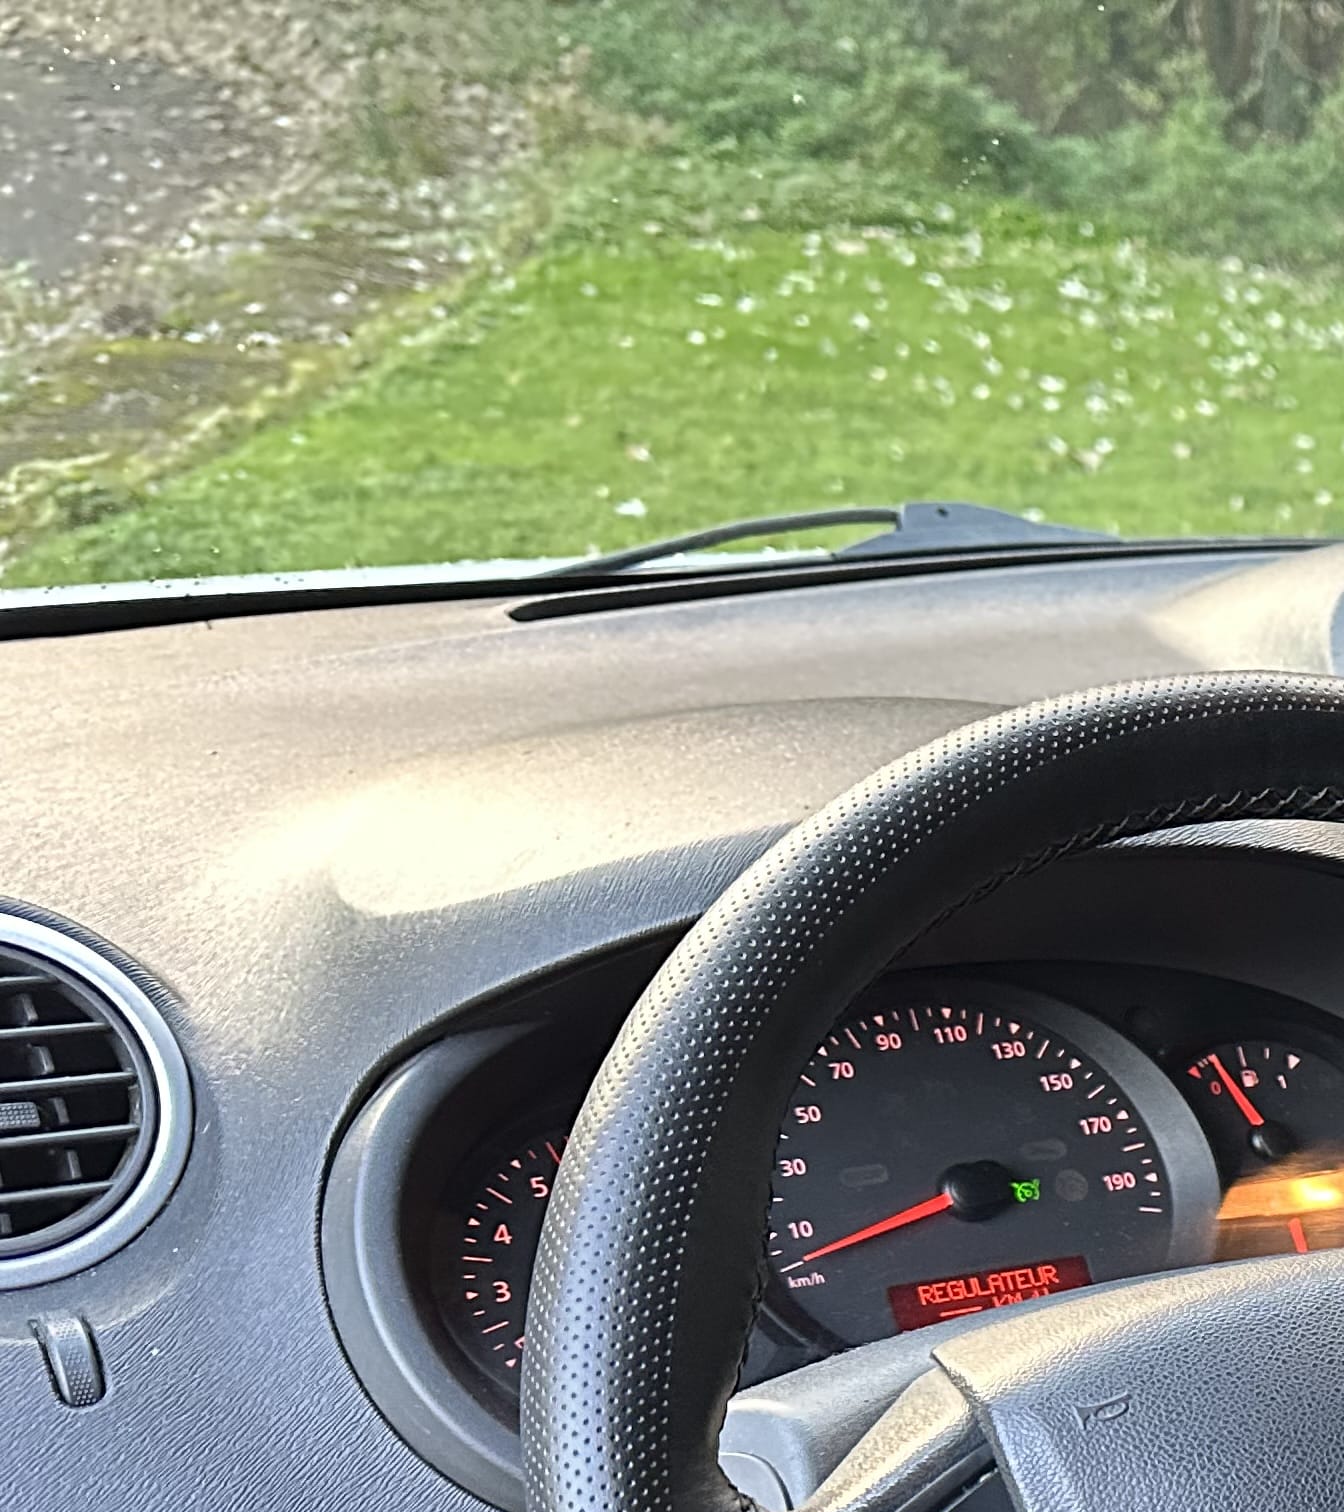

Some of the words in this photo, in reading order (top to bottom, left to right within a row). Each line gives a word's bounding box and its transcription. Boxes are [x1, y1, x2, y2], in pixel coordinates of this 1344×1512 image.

[874, 1033, 902, 1051] 90
[933, 1025, 967, 1044] 110
[991, 1041, 1026, 1060] 130
[828, 1061, 855, 1080] 70
[1039, 1073, 1073, 1092] 150
[1210, 1081, 1222, 1095] 0
[1277, 1074, 1287, 1089] 1
[794, 1105, 822, 1124] 50
[1078, 1116, 1112, 1135] 170
[778, 1158, 807, 1178] 30
[529, 1176, 549, 1198] 5
[1102, 1171, 1137, 1192] 190
[493, 1223, 513, 1245] 4
[787, 1220, 814, 1240] 10
[787, 1271, 826, 1289] km/h
[917, 1264, 1060, 1306] REGULATEUR
[492, 1281, 512, 1303] 3
